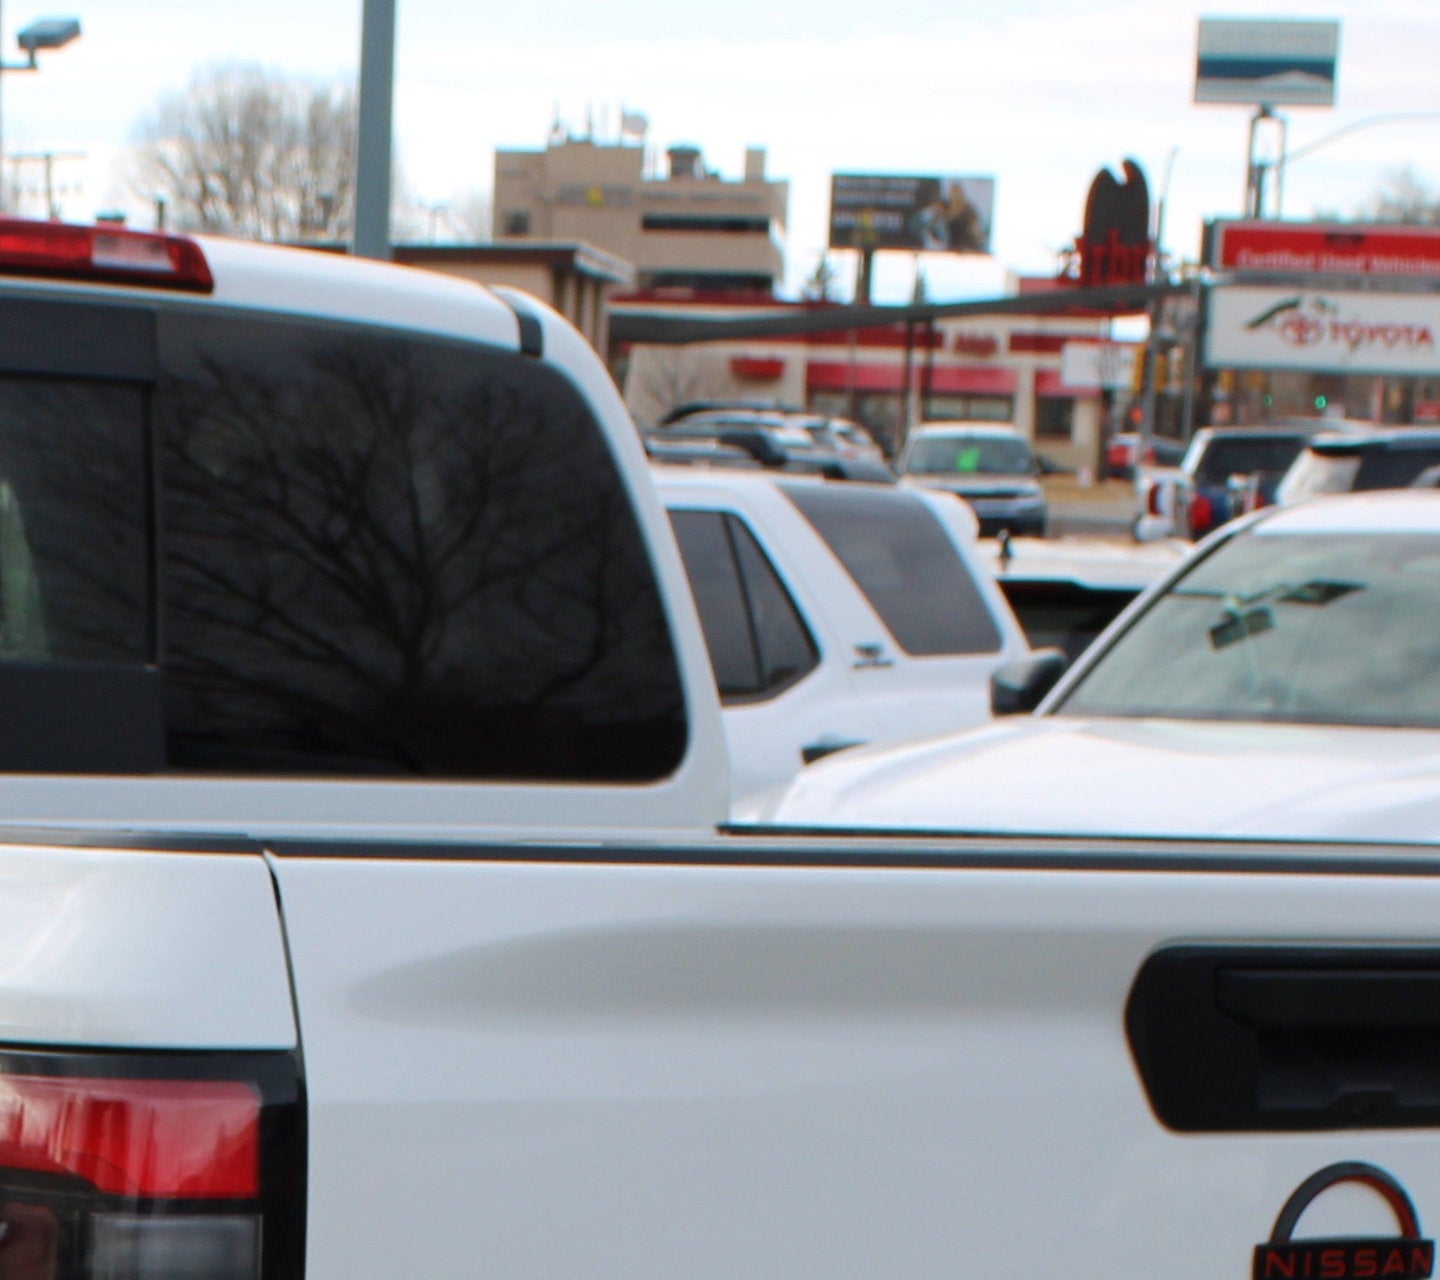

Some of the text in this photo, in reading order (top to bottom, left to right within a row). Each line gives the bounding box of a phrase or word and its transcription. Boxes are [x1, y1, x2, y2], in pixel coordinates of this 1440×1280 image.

[1236, 247, 1315, 272] Certified
[1321, 251, 1366, 272] Used
[1329, 319, 1434, 345] TOYOTA
[1264, 1247, 1432, 1278] NISSAN
